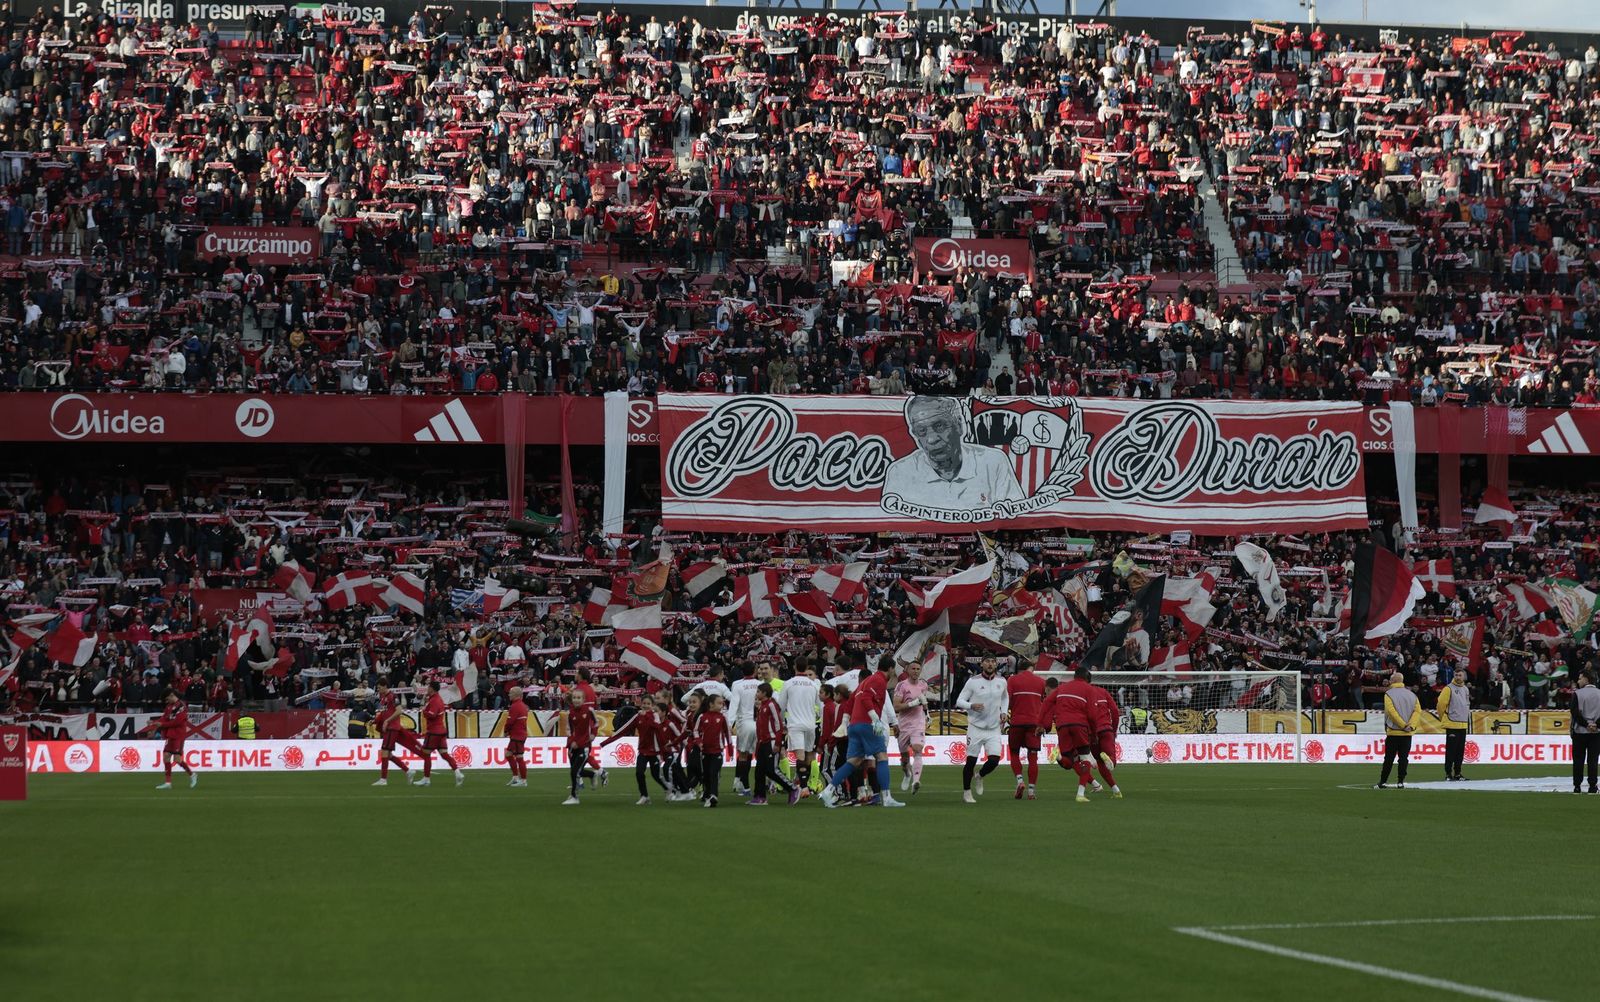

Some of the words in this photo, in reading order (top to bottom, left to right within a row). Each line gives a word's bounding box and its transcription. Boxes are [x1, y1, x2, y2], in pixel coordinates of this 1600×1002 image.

[64, 0, 88, 17] La
[101, 0, 174, 18] Giralda
[927, 15, 943, 33] el
[205, 232, 312, 257] Cruzcampo
[944, 249, 1011, 268] Midea
[72, 409, 165, 434] Midea
[241, 407, 269, 427] JD
[667, 397, 892, 496] Paco
[1092, 402, 1358, 500] Durán
[883, 495, 971, 522] CARPINTERO
[974, 508, 992, 522] DE
[996, 490, 1057, 516] NERVIÓN
[100, 716, 136, 740] 24
[70, 750, 87, 760] EA
[152, 749, 212, 768] JCE
[217, 749, 272, 768] TIME
[483, 746, 543, 765] JUCE
[545, 746, 601, 765] TIE
[1183, 742, 1239, 761] JUICE
[1243, 742, 1294, 761] TIME
[1491, 743, 1545, 761] JUICE
[1549, 743, 1574, 761] TI
